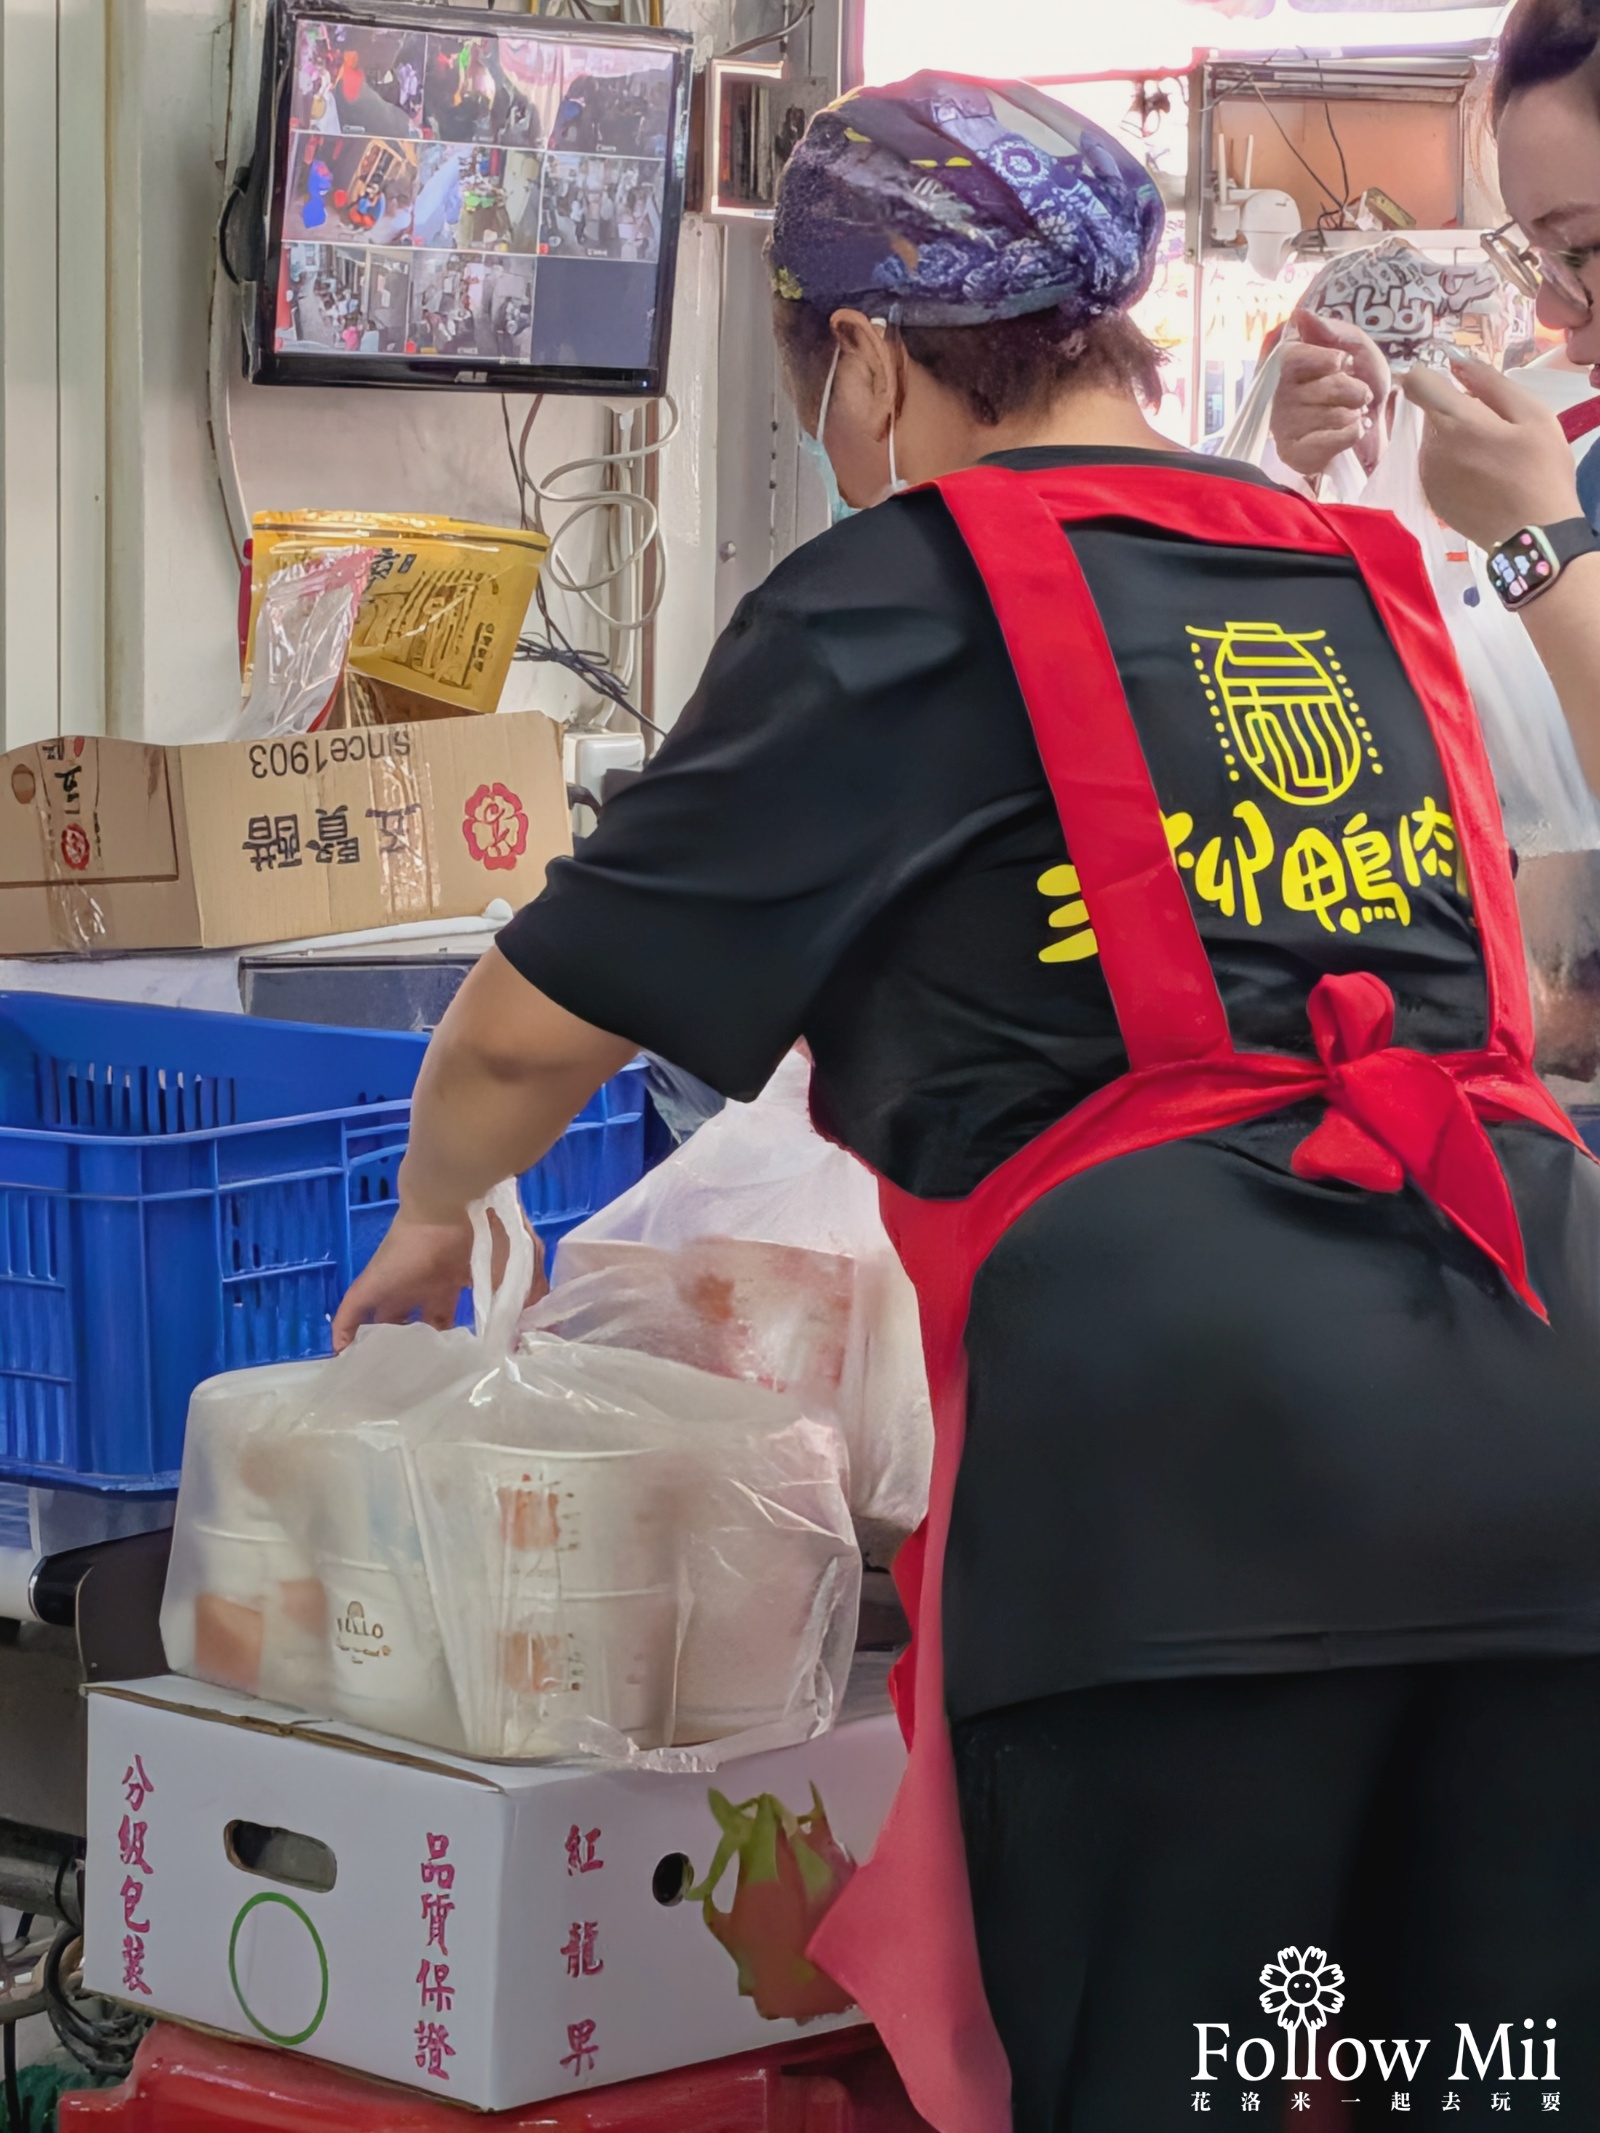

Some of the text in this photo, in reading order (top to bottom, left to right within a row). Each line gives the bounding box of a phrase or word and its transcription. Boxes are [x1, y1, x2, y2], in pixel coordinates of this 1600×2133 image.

[413, 1831, 457, 2081] 品質保證
[559, 1824, 604, 2075] 紅龍果
